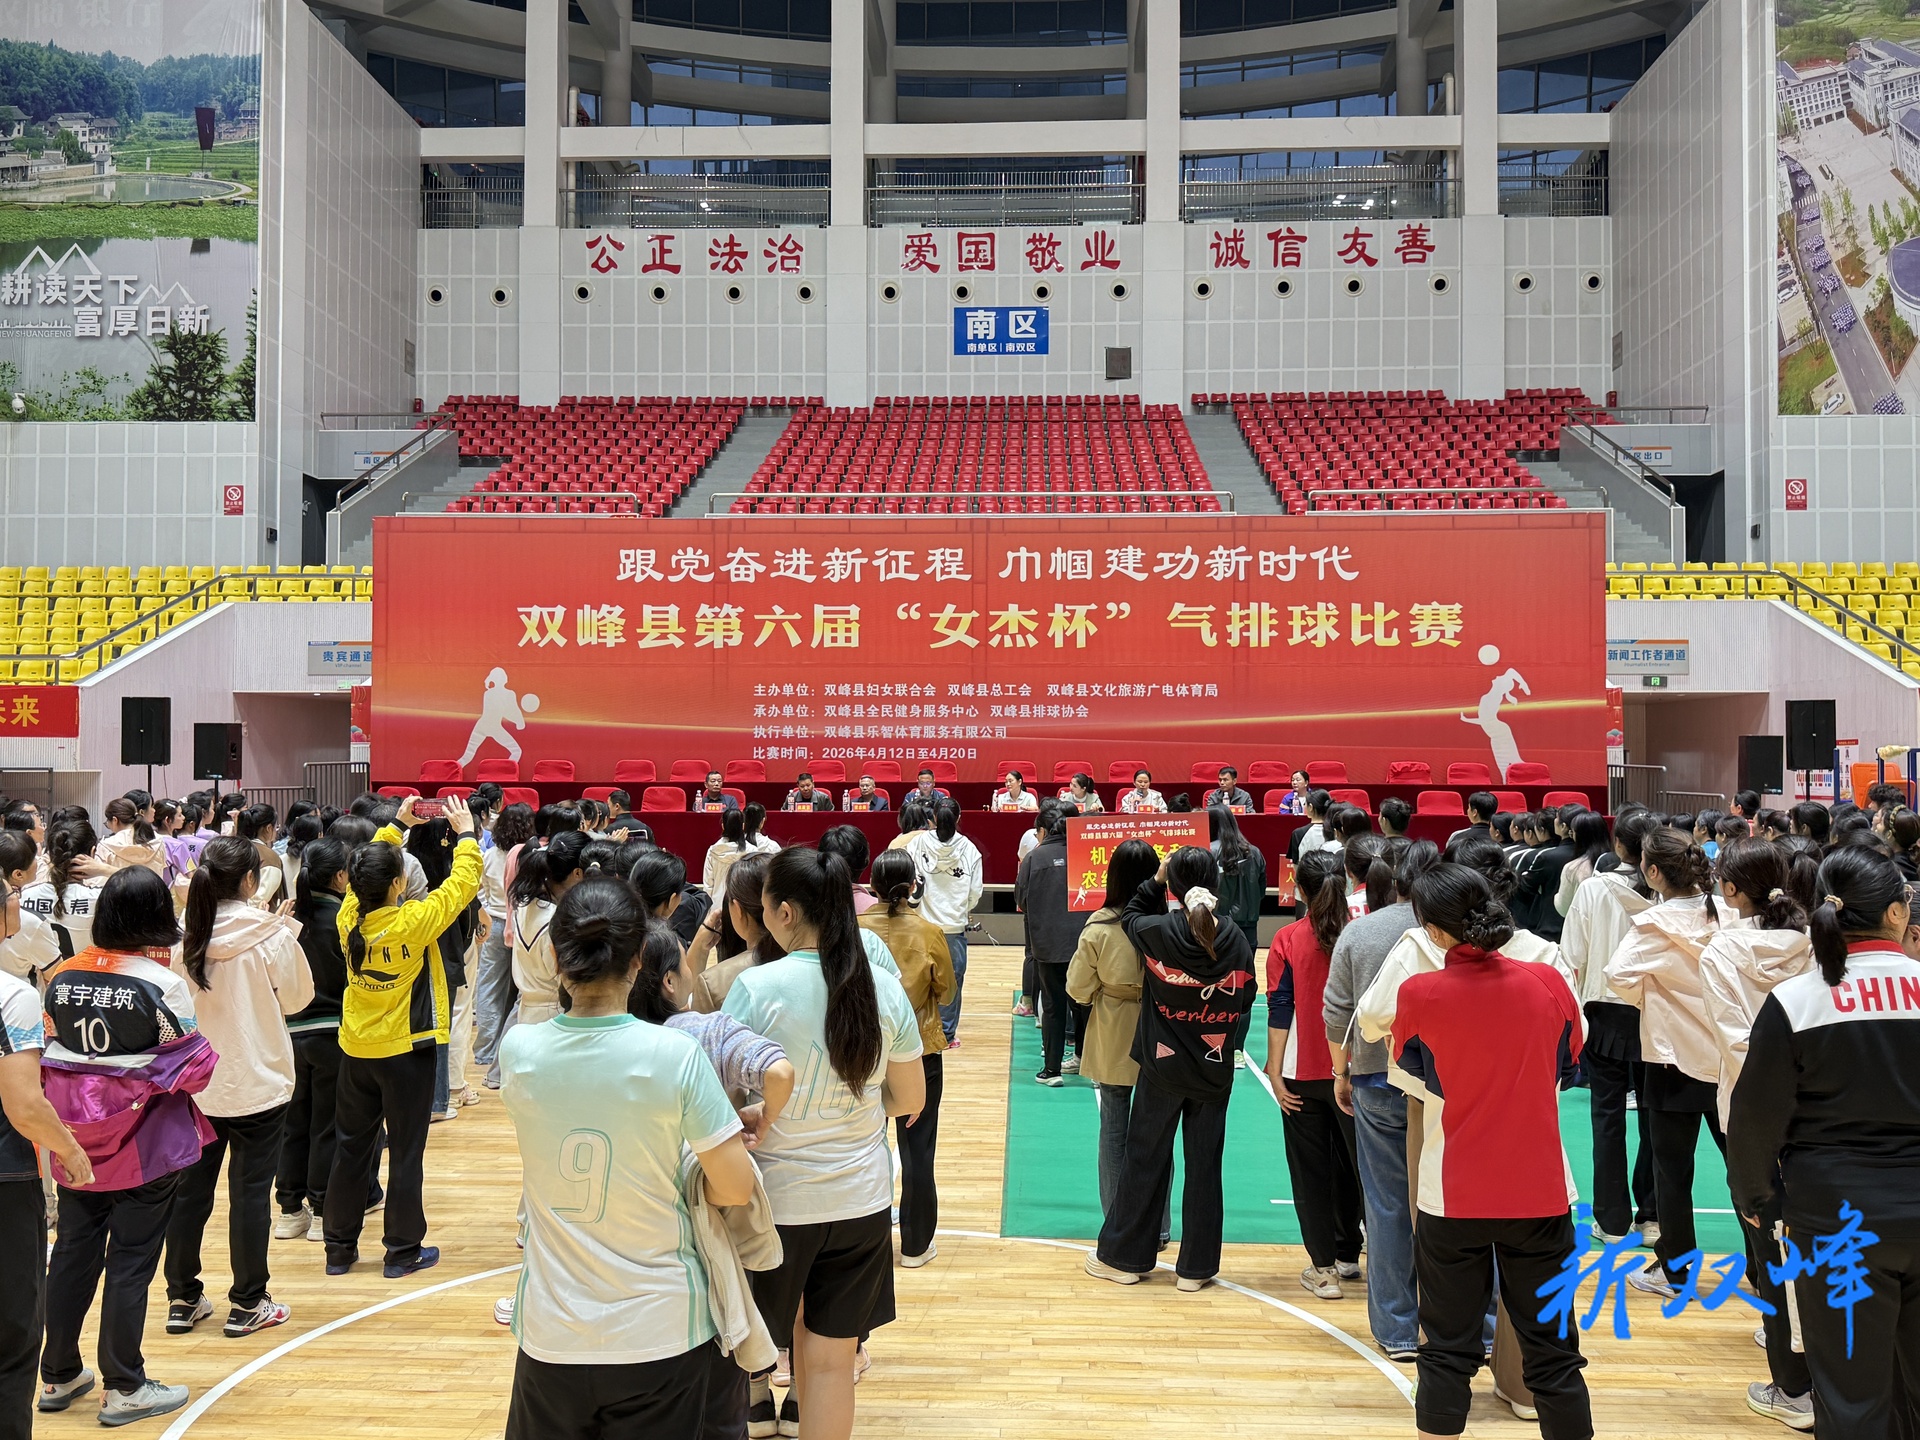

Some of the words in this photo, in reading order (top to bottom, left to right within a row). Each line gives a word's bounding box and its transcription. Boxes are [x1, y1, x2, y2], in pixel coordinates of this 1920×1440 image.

[1, 273, 138, 305] 耕读天下
[16, 330, 71, 338] SHUANGFENG
[73, 304, 210, 337] 富厚日新
[966, 310, 1037, 340] 南区
[616, 546, 973, 584] 跟党奋进新征程
[998, 544, 1361, 582] 巾帼建功新时代
[1608, 649, 1686, 661] 新闻工作者通道
[947, 683, 1032, 697] 双峰县总工会
[1047, 683, 1219, 697] 双峰县文化旅游广电体育局
[990, 704, 1089, 718] 双峰县排球协会
[23, 898, 89, 915] 中国寿
[54, 983, 136, 1011] 寰宇建筑
[73, 1017, 111, 1053] 10
[550, 1127, 613, 1224] 9
